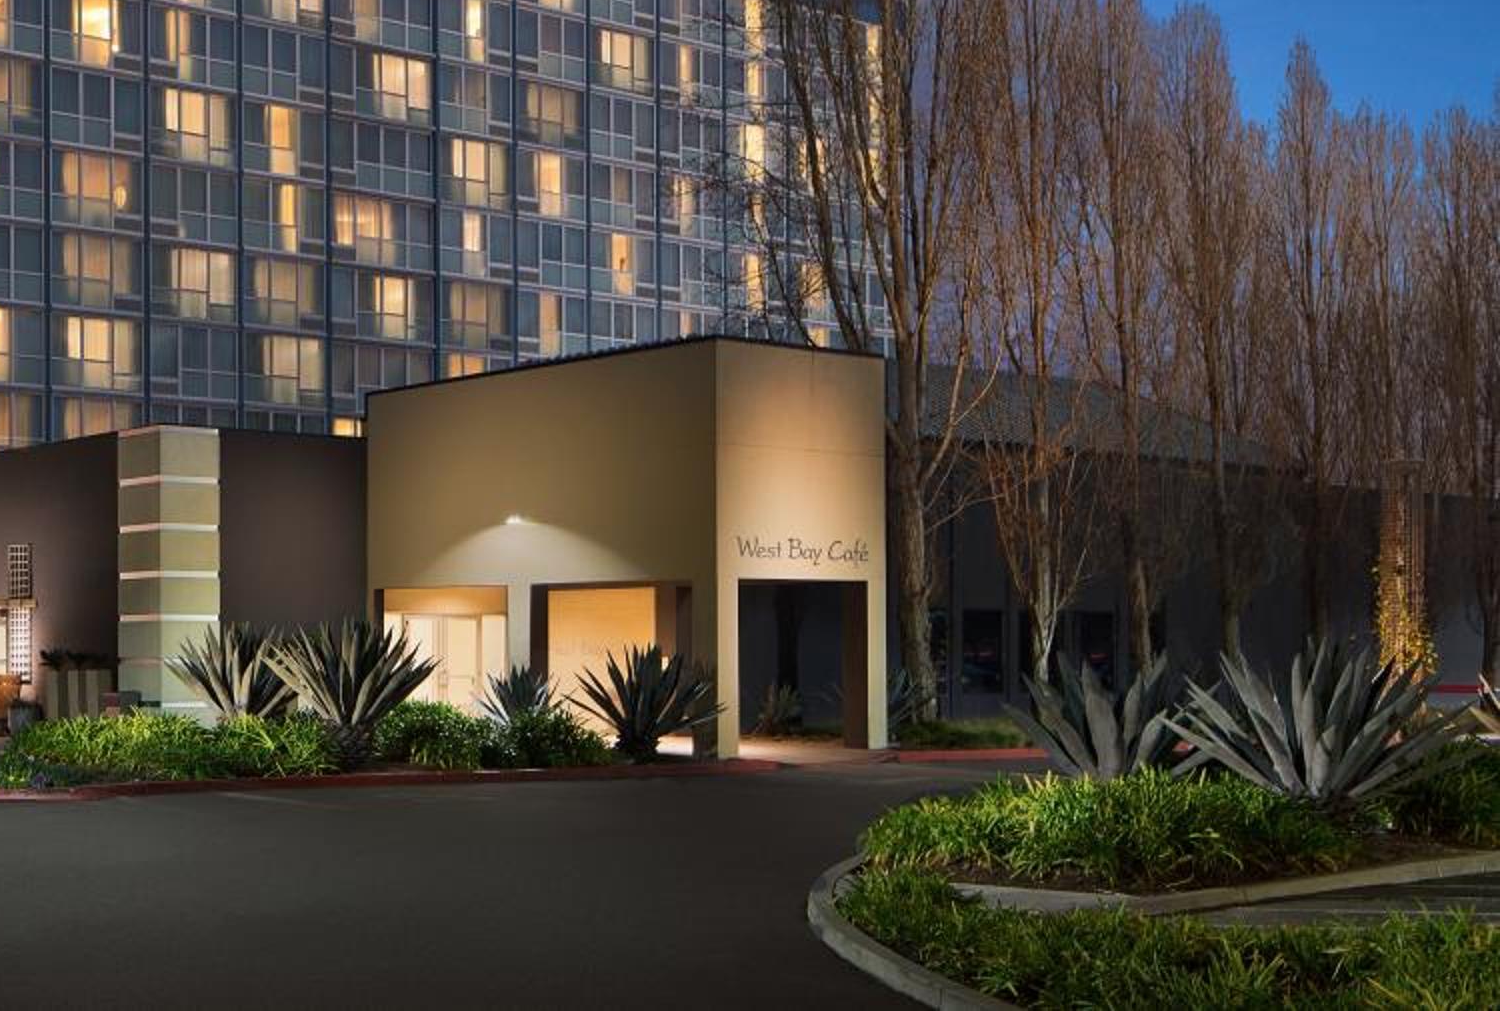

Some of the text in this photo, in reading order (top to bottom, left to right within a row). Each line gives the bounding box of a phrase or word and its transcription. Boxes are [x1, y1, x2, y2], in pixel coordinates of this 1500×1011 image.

[736, 535, 869, 567] West Bay Café
